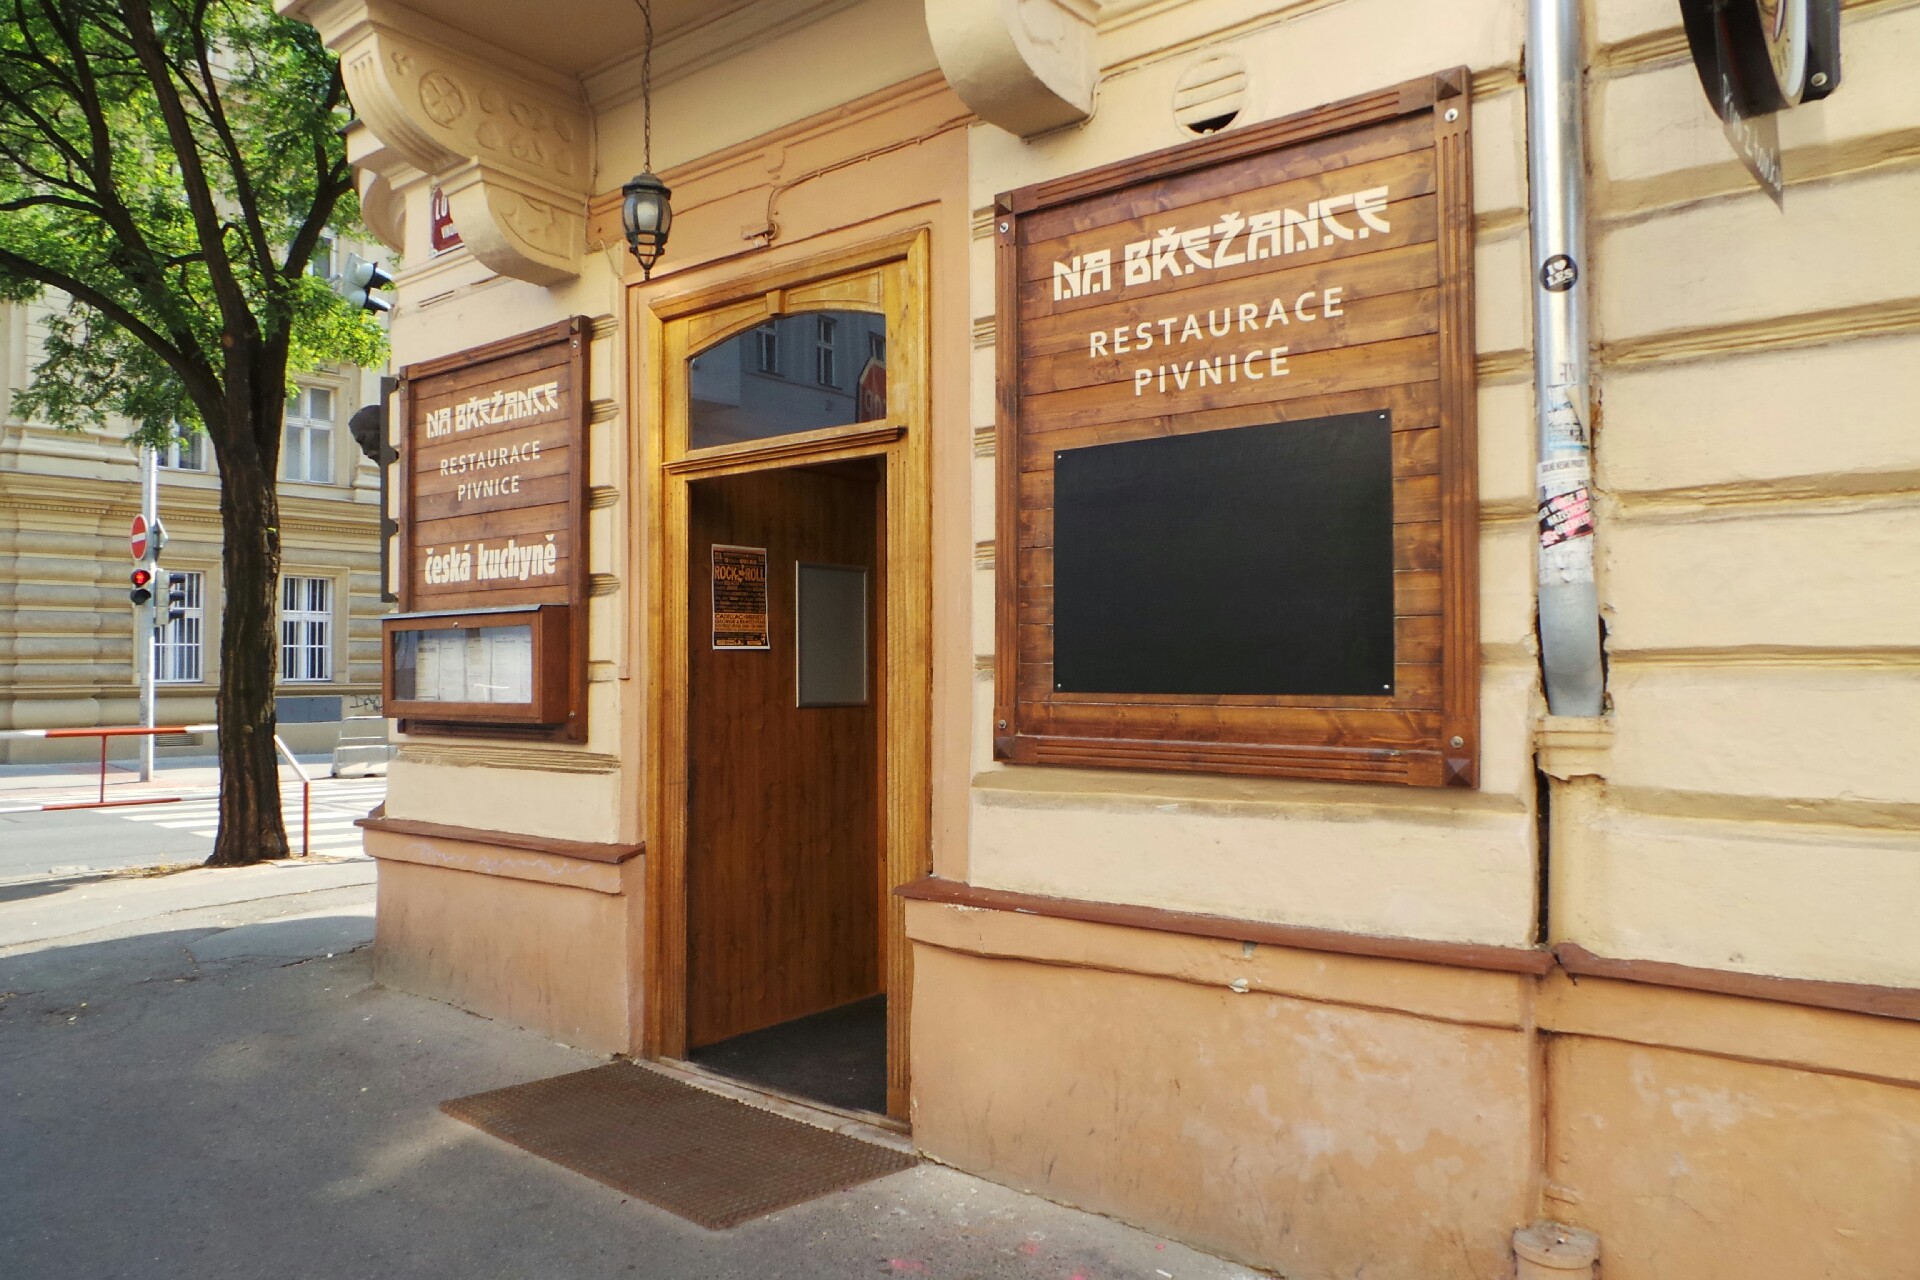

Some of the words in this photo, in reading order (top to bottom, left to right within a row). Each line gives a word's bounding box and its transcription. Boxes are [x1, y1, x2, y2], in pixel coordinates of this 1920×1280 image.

[1053, 248, 1111, 301] NA
[1124, 185, 1391, 286] BŘEŽANCE
[1090, 286, 1344, 358] RESTAURACE
[1135, 345, 1290, 396] PIVNICE
[426, 407, 451, 438] NA
[455, 381, 558, 432] BŘEŽANCE
[440, 440, 541, 476] RESTAURACE
[458, 475, 520, 501] PIVNICE
[425, 543, 471, 584] česká
[477, 534, 556, 581] kuchyně
[714, 565, 738, 580] ROCK
[744, 566, 765, 581] ROLL
